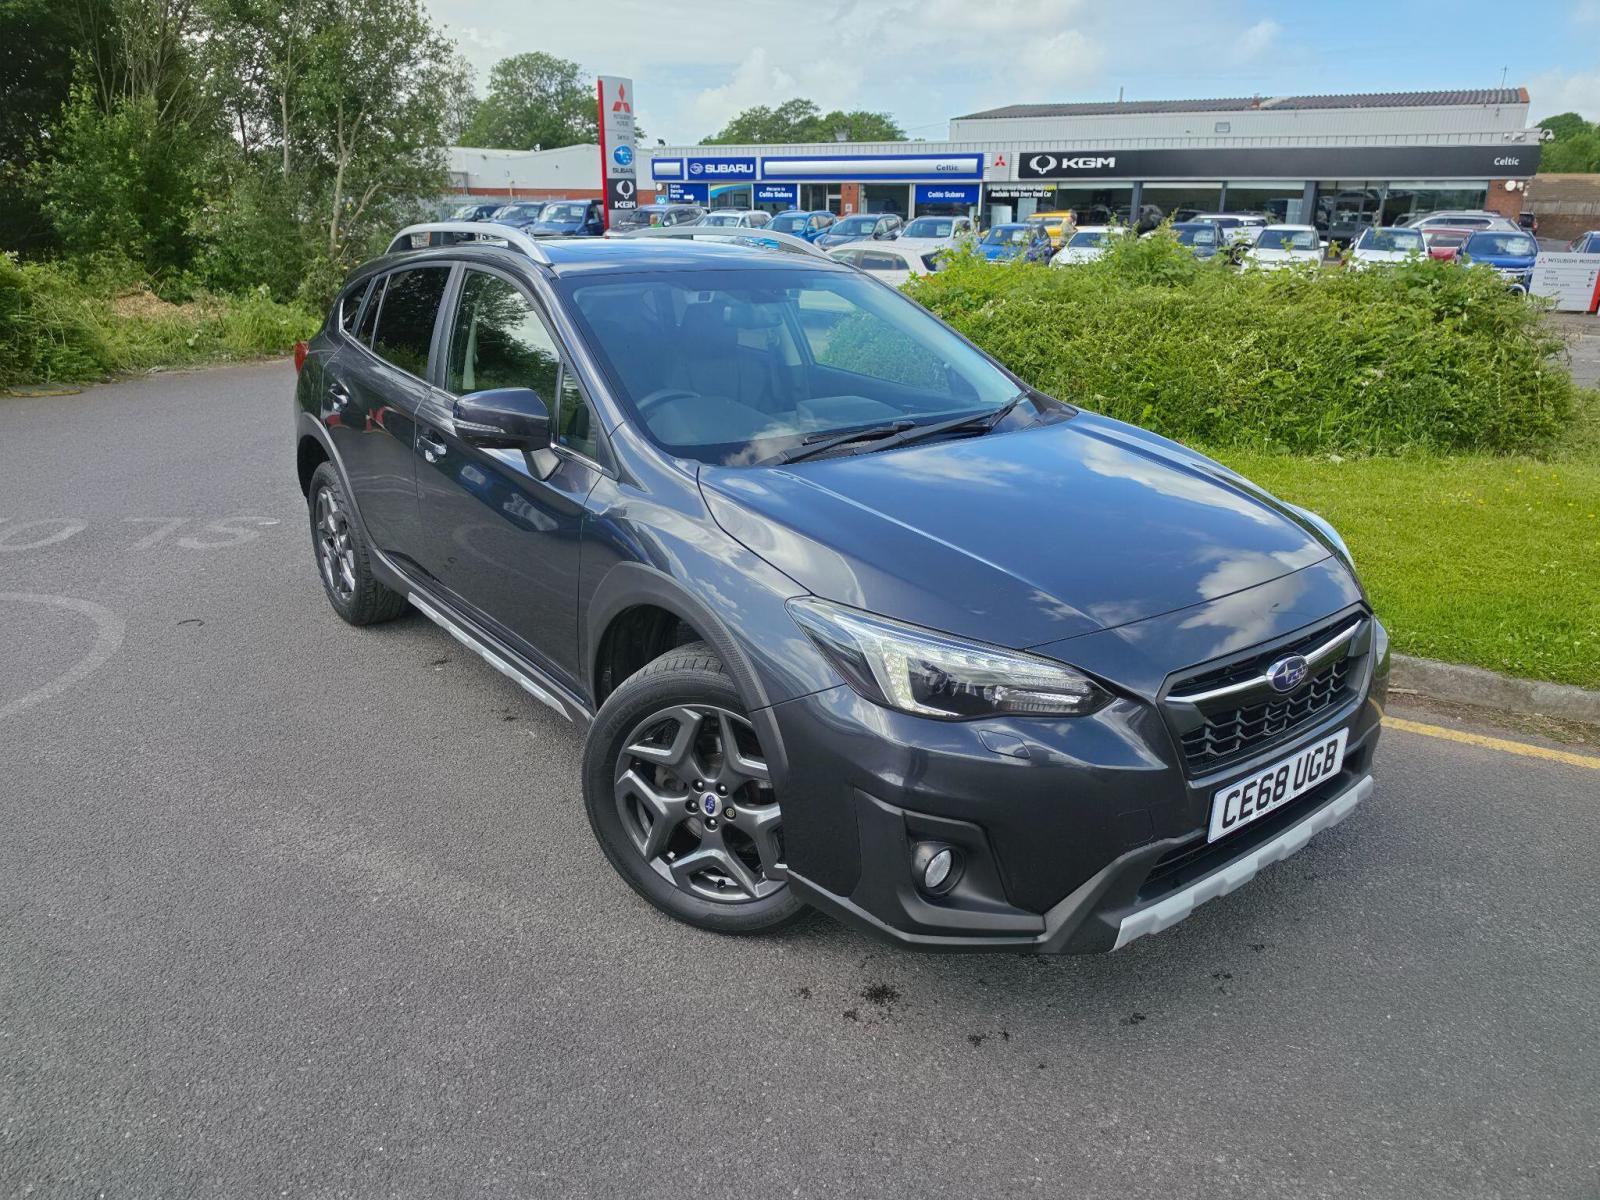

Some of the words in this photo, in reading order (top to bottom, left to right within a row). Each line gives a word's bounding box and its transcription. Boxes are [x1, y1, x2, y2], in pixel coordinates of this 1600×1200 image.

[1062, 157, 1116, 169] KGM
[1494, 157, 1520, 166] Celtic
[704, 163, 753, 173] SUBARU
[614, 200, 636, 209] KGM
[1222, 764, 1290, 829] CE68
[1293, 739, 1338, 791] UGB
